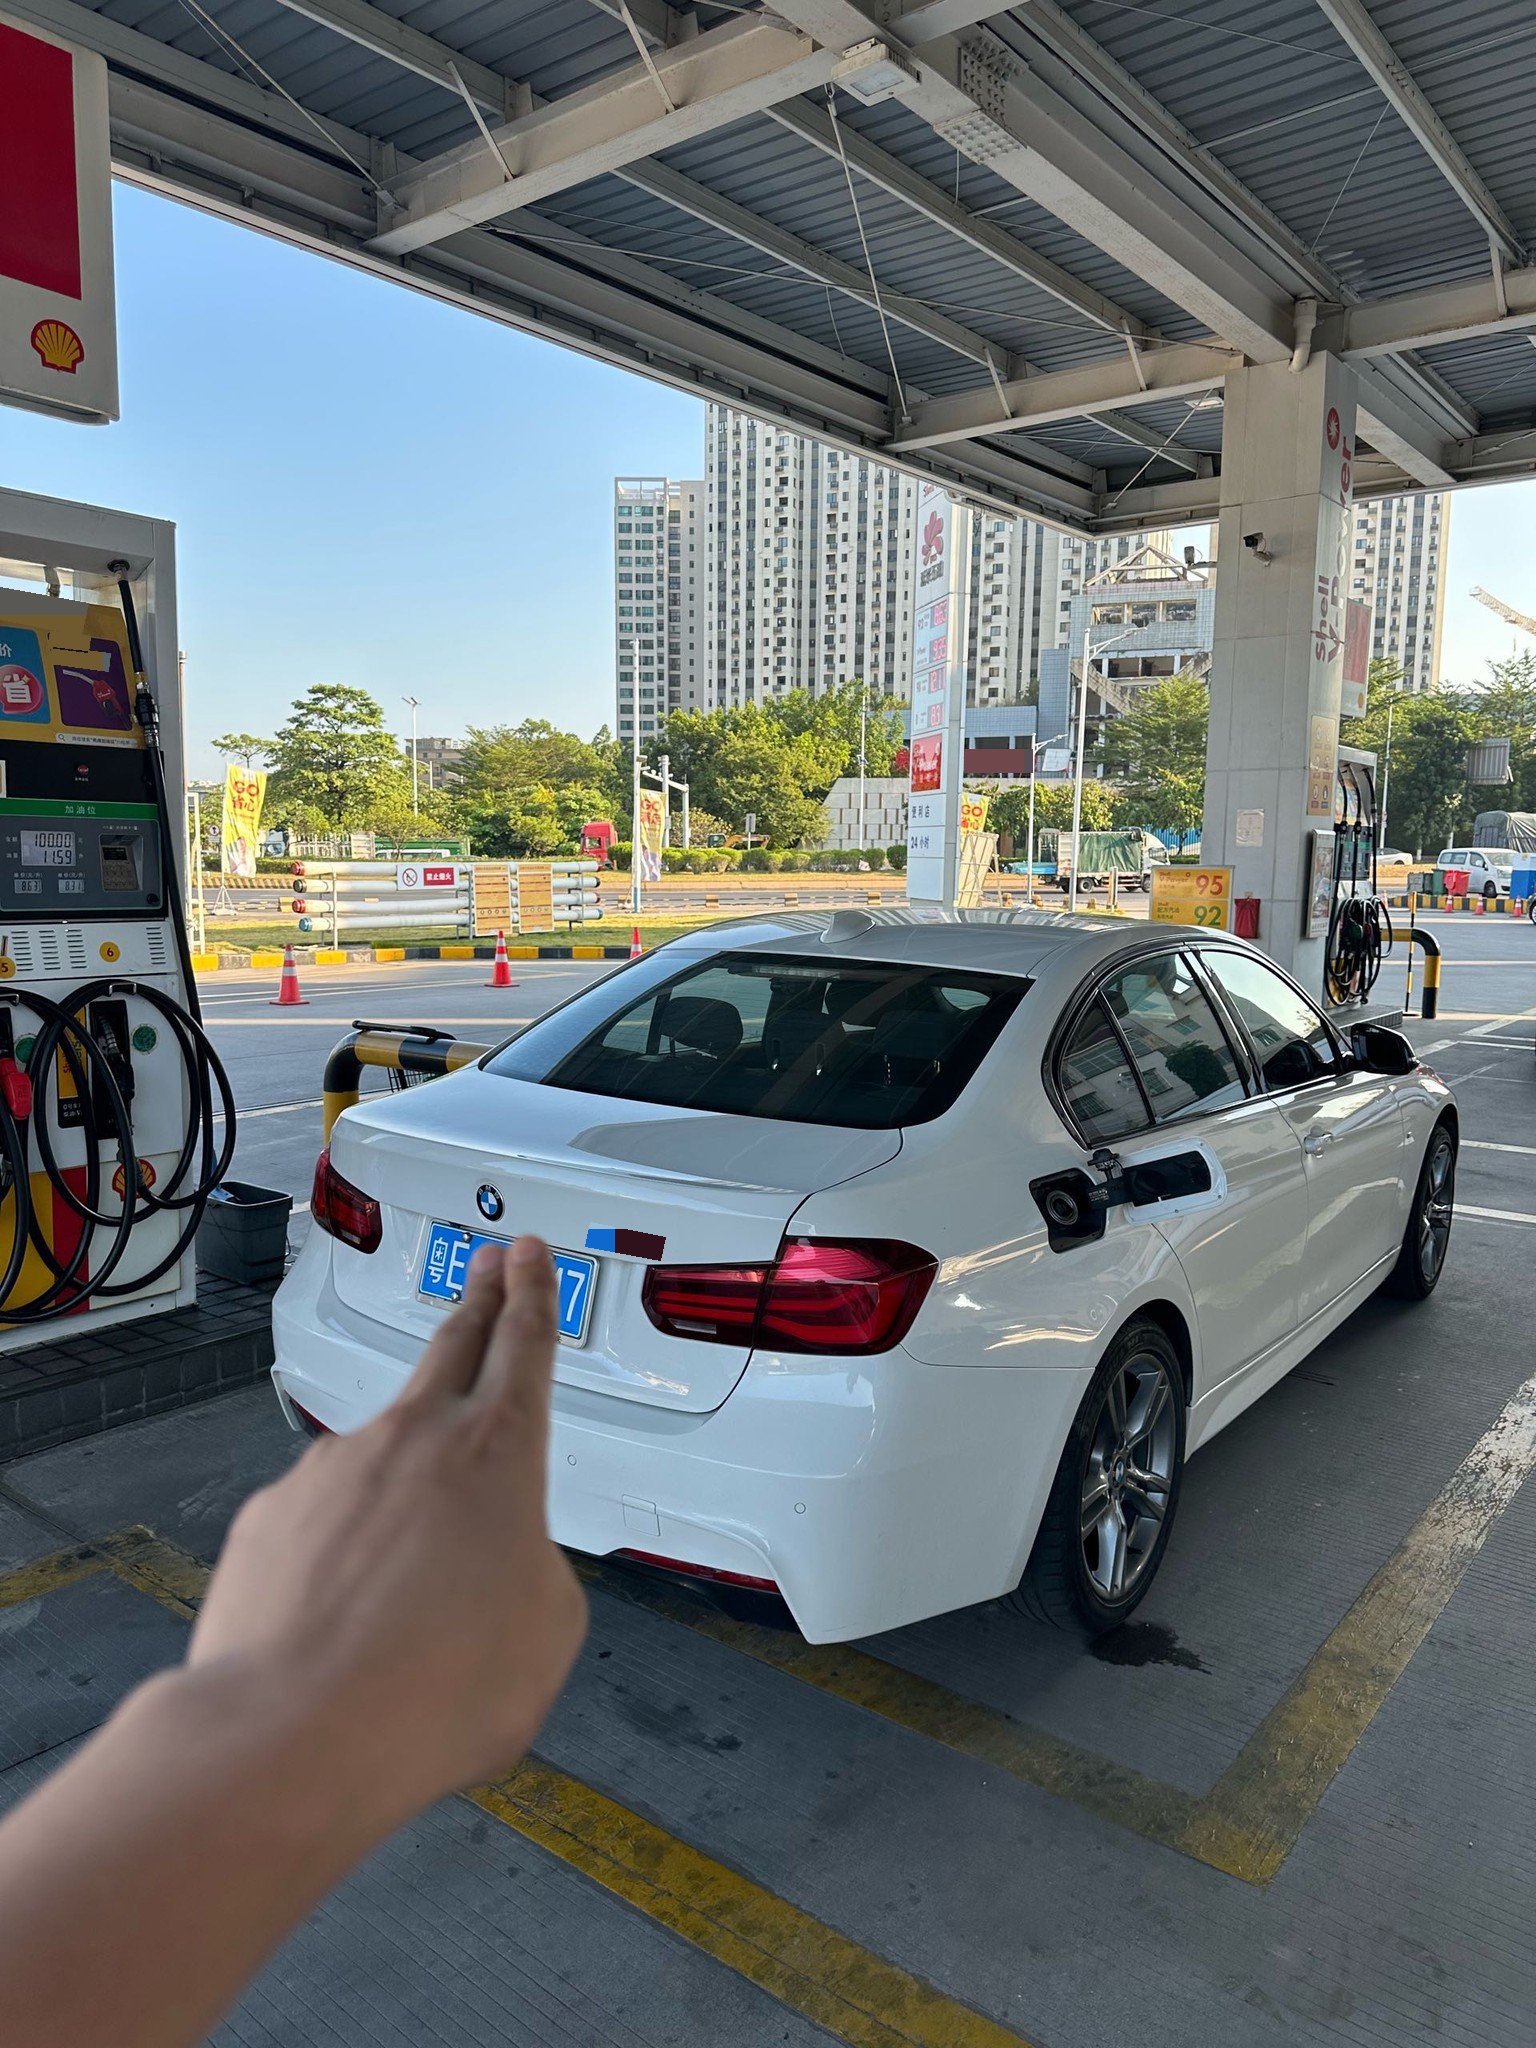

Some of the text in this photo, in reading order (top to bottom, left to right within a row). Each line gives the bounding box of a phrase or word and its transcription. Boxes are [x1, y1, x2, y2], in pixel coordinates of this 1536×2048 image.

[1315, 575, 1330, 663] Shell
[233, 781, 259, 797] GO
[65, 805, 96, 815] 加油位
[961, 805, 983, 817] GO
[1196, 874, 1223, 896] 95
[1194, 905, 1221, 926] 92
[106, 947, 115, 958] 6
[1, 962, 9, 973] 5
